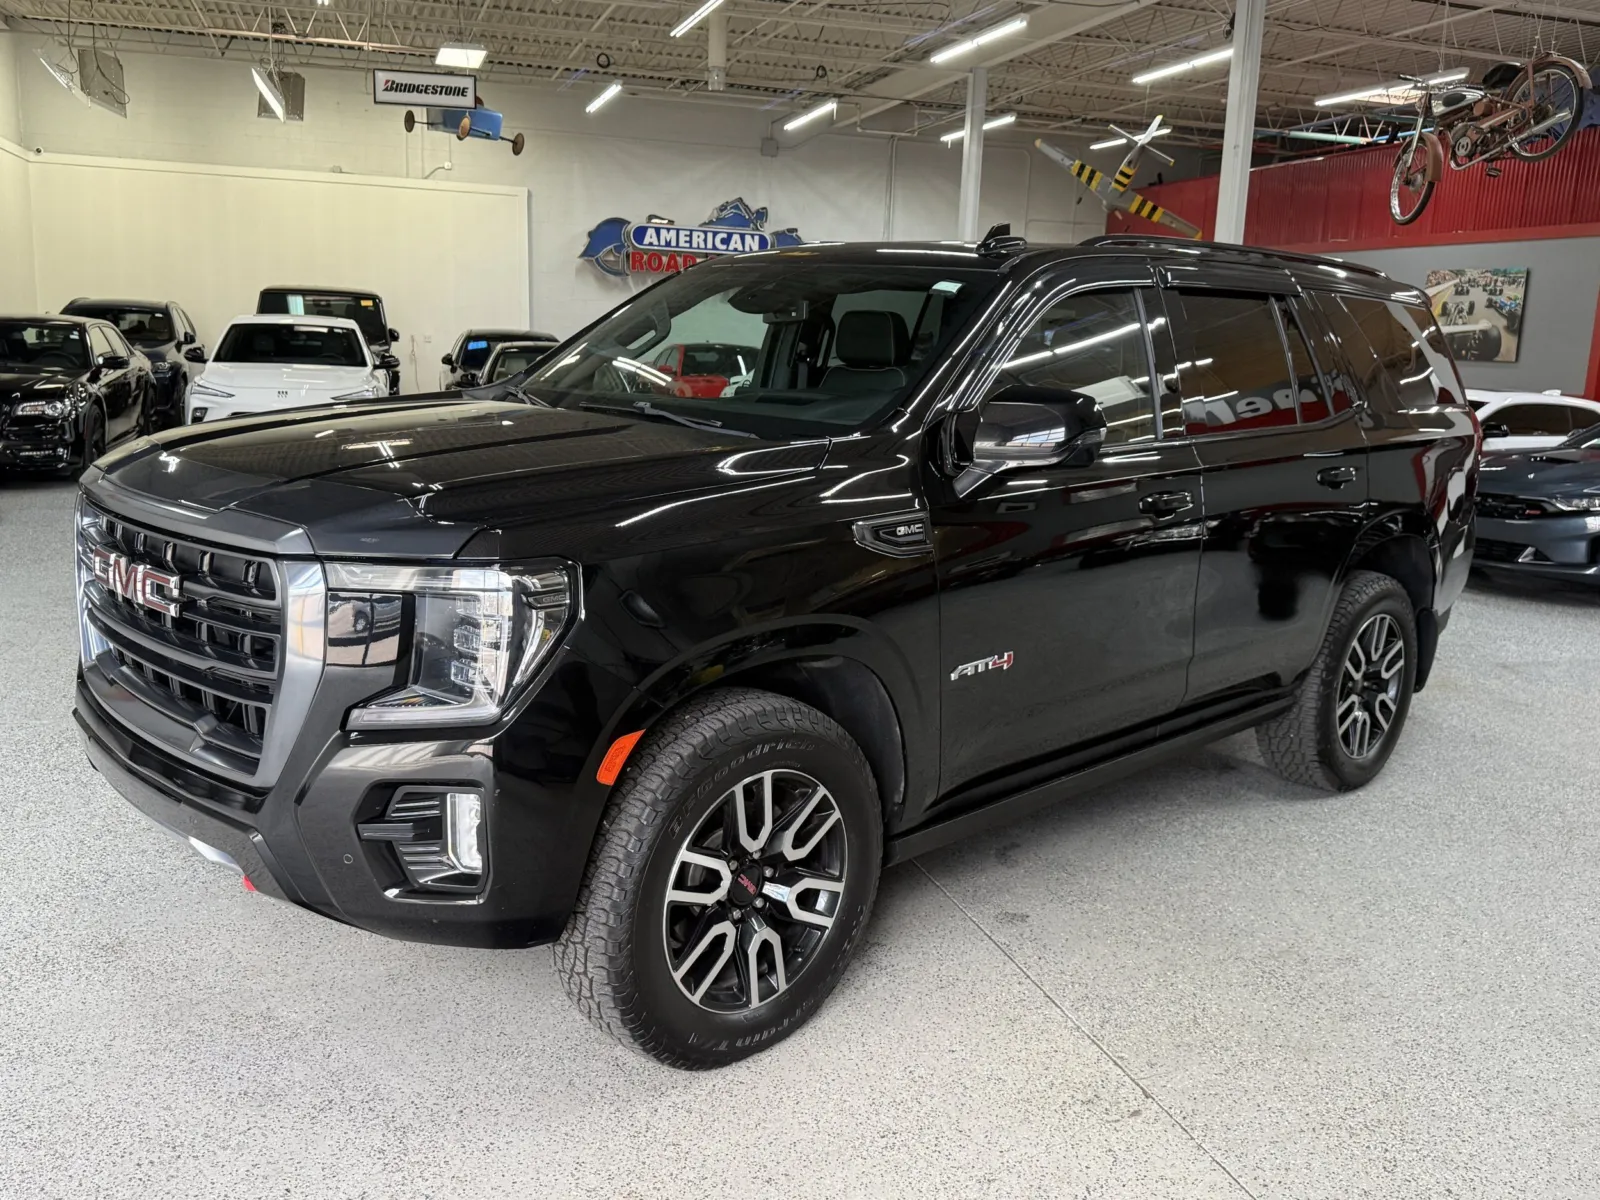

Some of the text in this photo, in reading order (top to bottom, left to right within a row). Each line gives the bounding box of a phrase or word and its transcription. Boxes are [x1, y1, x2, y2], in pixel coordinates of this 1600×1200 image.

[382, 79, 469, 97] BRIDGESTONE
[642, 227, 760, 251] AMERICAN
[630, 251, 698, 273] ROAD
[896, 523, 923, 536] GMC
[92, 544, 181, 618] GMC
[949, 650, 1014, 681] AT4
